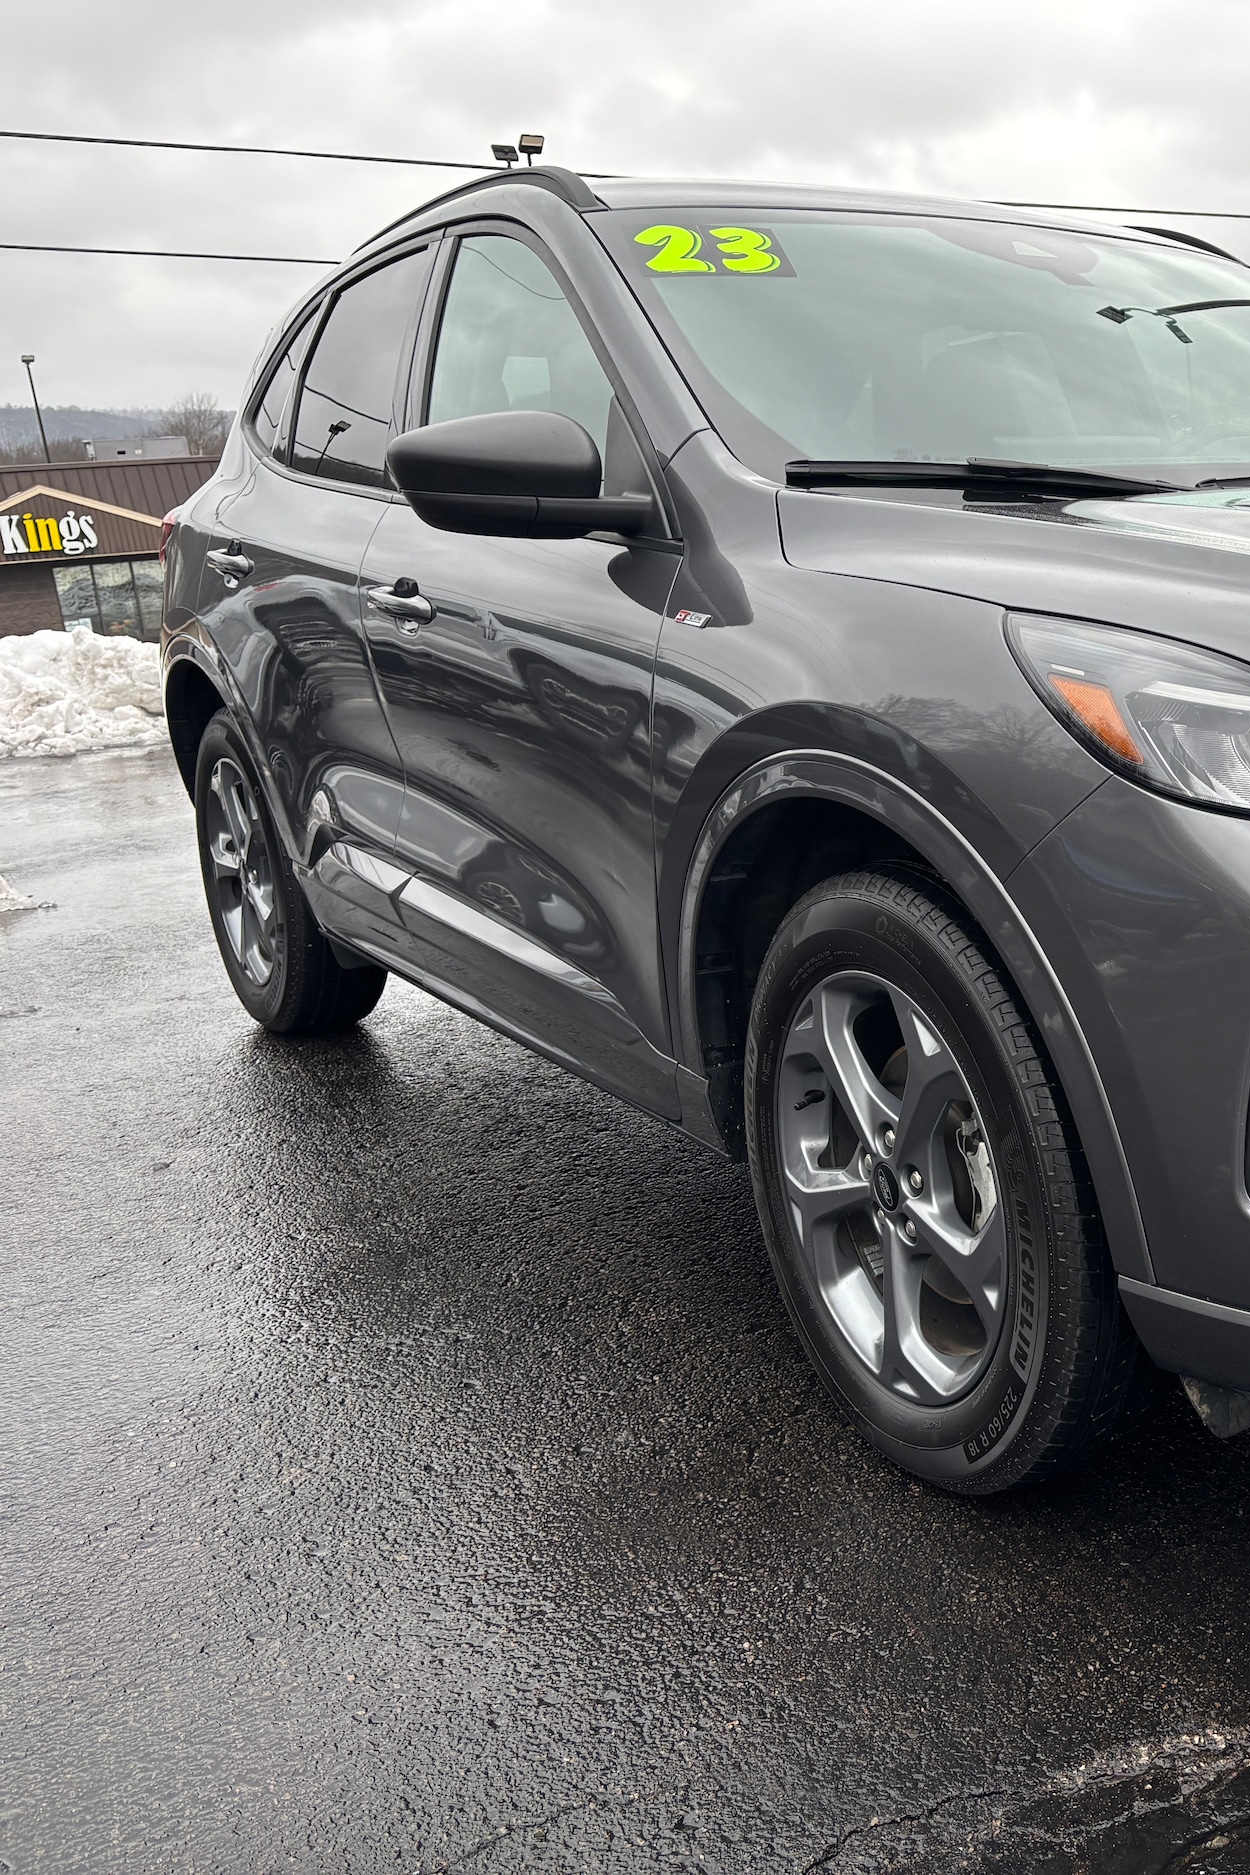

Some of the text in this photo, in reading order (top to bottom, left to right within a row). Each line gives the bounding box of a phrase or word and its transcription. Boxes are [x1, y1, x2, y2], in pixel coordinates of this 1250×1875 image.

[633, 224, 782, 274] 23
[0, 510, 99, 556] Kings
[1014, 1198, 1036, 1373] MICHELIN
[967, 1386, 1018, 1457] 225/60 R 18
